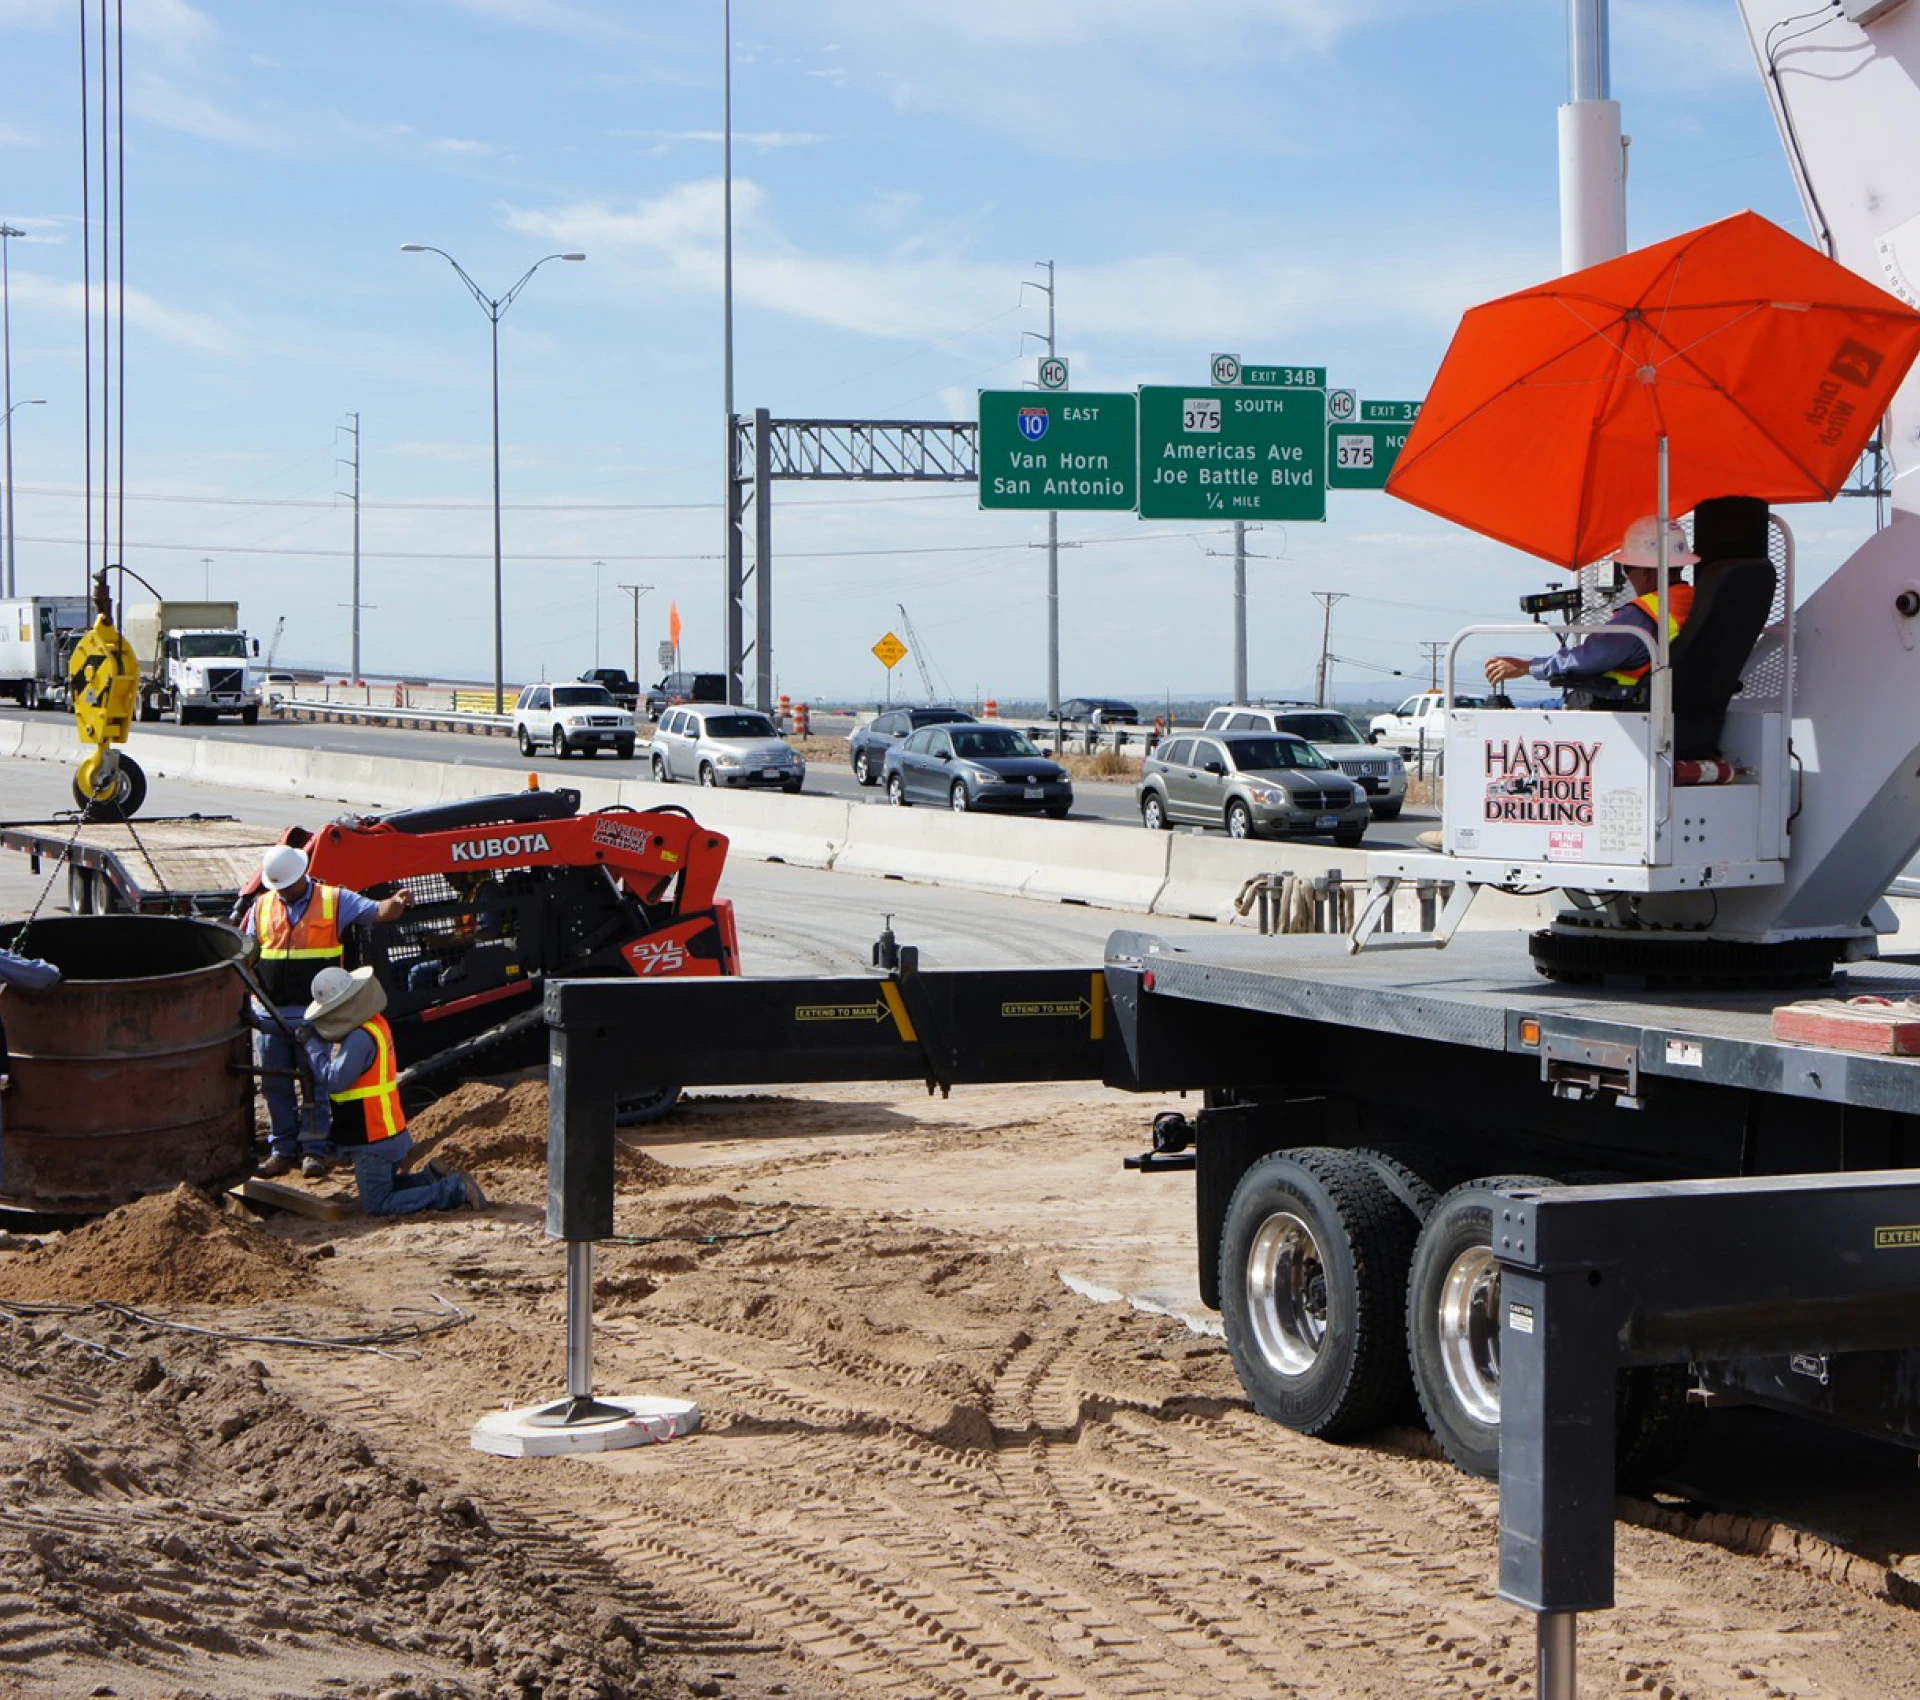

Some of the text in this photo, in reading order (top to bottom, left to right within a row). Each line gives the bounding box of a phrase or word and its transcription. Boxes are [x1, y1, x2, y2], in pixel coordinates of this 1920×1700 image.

[1045, 367, 1062, 381] HC
[1217, 363, 1234, 378] HC
[1251, 369, 1316, 385] EXIT 34B
[1234, 400, 1284, 413] SOUTH
[1334, 397, 1350, 412] HC
[1370, 405, 1396, 416] EXIT
[1063, 408, 1100, 420] EAST
[1184, 411, 1220, 429] 375
[1024, 416, 1042, 434] 10
[1163, 442, 1304, 461] Americas Ave
[1338, 447, 1373, 465] 375
[1009, 452, 1108, 470] Van Horn
[1153, 467, 1313, 486] Joe Battle Blvd
[994, 477, 1124, 495] San Antonio
[1232, 496, 1261, 508] MILE
[1485, 738, 1602, 777] HARDY
[1539, 779, 1592, 801] HOLE
[1485, 800, 1593, 825] DRILLING
[596, 818, 652, 839] HARDY
[451, 833, 551, 862] KUBOTA
[632, 940, 682, 957] SVL
[641, 953, 683, 974] 75
[799, 1008, 836, 1018] EXTEND
[837, 1008, 850, 1016] TO
[1004, 1005, 1040, 1013] EXTEND
[1042, 1005, 1054, 1013] TO
